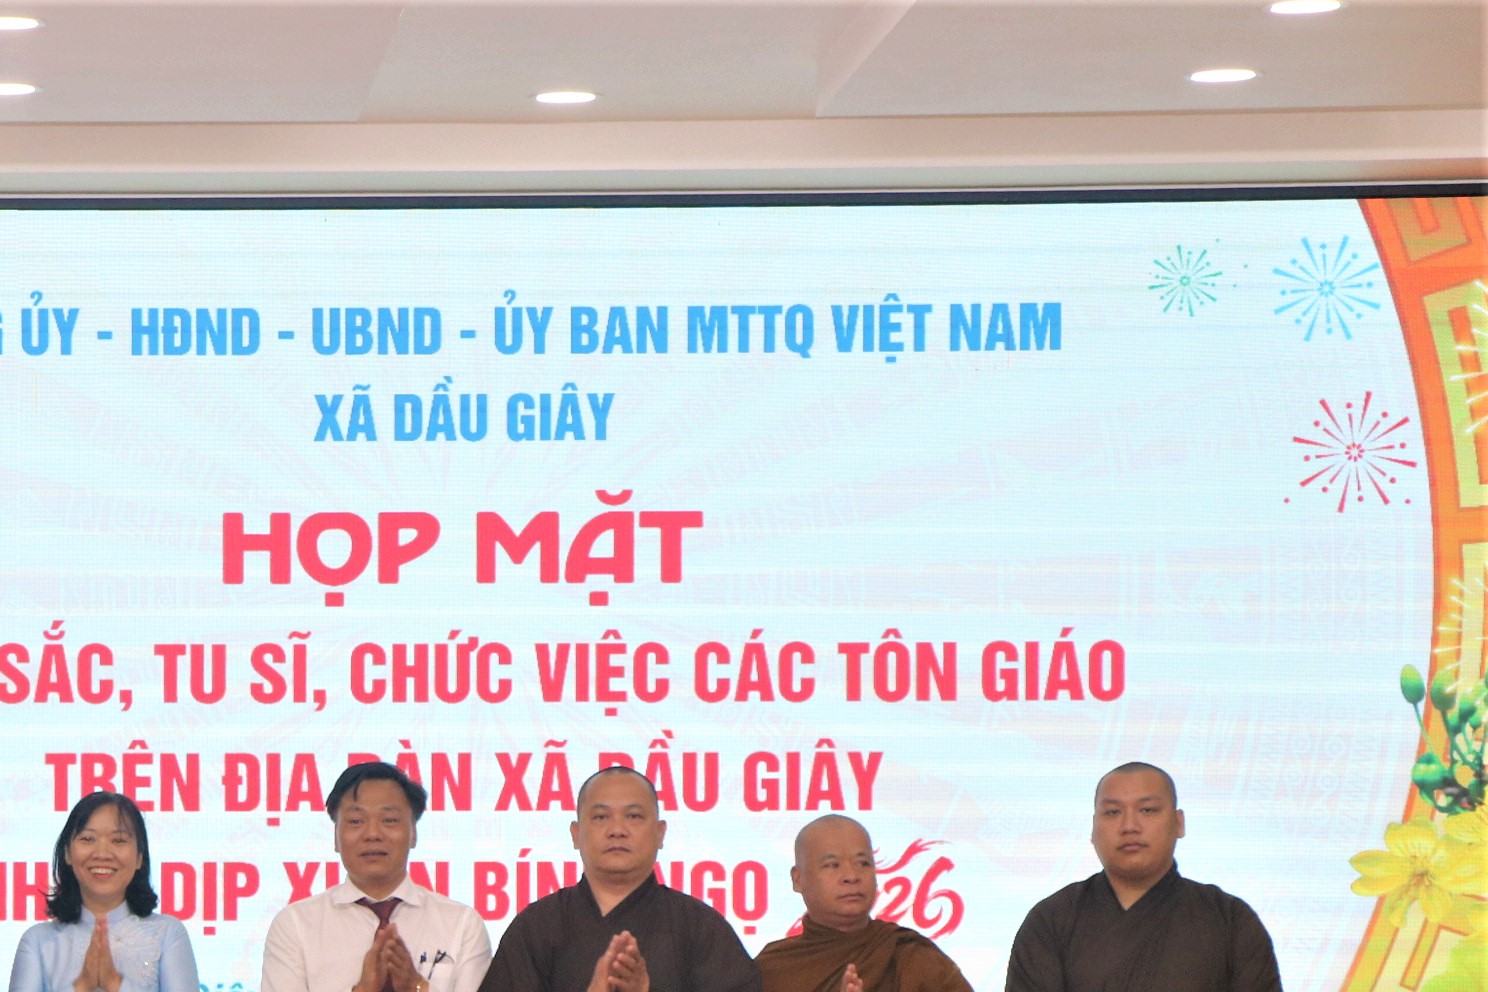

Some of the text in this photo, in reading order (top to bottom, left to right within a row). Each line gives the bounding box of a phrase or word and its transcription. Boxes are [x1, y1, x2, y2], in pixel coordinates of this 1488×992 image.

[22, 290, 80, 356] ỦY
[132, 307, 261, 356] HĐND
[313, 307, 443, 356] UBND
[495, 289, 554, 355] ỦY
[571, 305, 669, 355] BAN
[688, 304, 815, 358] MTTQ
[832, 293, 933, 363] VIỆT
[950, 302, 1062, 352] NAM
[315, 376, 615, 442] XÃ DẦU GIÂY
[223, 489, 703, 606] HỌP MẶT
[154, 645, 226, 704] TU
[250, 632, 326, 711] SĨ,
[351, 630, 512, 704] CHỨC
[535, 630, 669, 717] VIỆC
[695, 630, 815, 703] CÁC
[839, 629, 957, 703] TÔN
[982, 628, 1125, 702] GIÁO
[45, 739, 200, 812] TRÊN
[222, 753, 326, 826] ĐỊA
[495, 740, 576, 811] XÃ
[743, 738, 882, 812] GIÂY
[160, 861, 261, 936] DỊP
